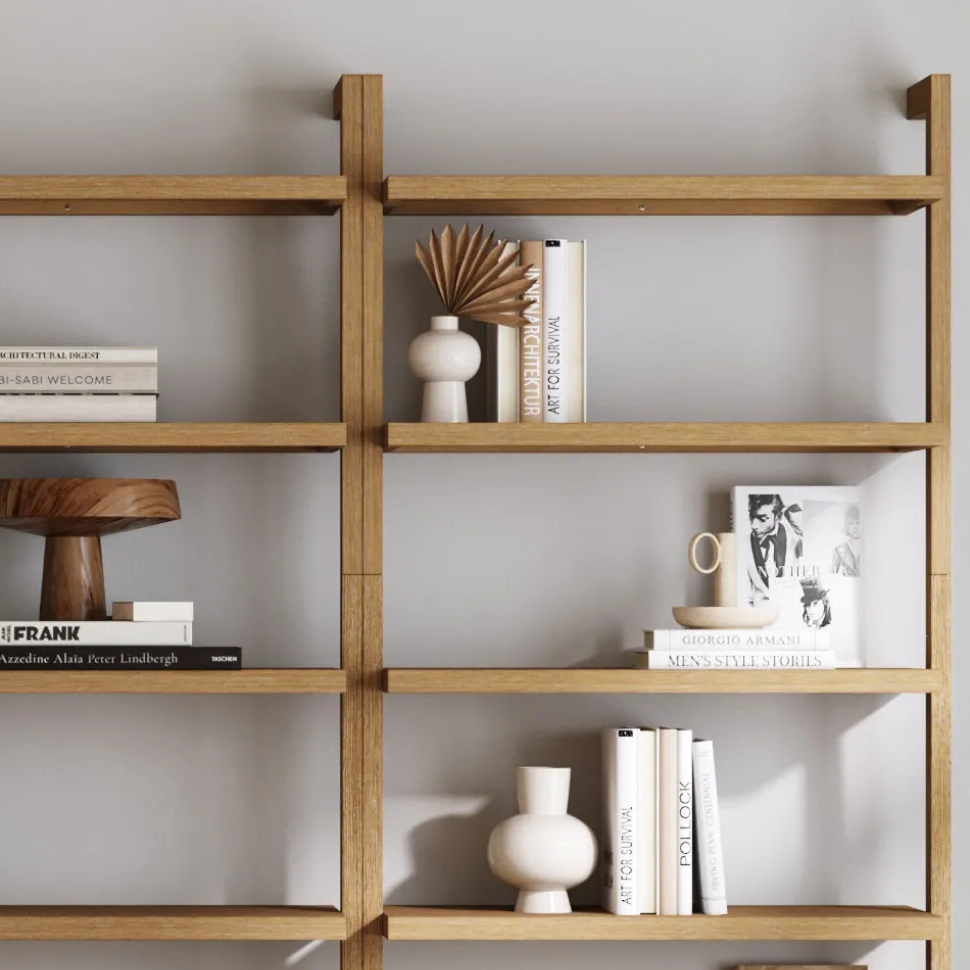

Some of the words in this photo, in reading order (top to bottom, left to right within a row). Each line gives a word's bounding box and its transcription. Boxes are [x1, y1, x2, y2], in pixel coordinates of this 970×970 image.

[548, 316, 560, 365] SURVIVAL
[69, 351, 100, 360] DIGEST
[47, 375, 113, 385] WELCOME
[548, 368, 560, 389] FOR
[548, 391, 560, 415] ART
[13, 626, 80, 641] FRANK
[682, 635, 740, 645] GIORGIO
[746, 635, 801, 645] ARMANI
[88, 653, 116, 664] Peter
[120, 652, 178, 667] Lindbergh
[668, 655, 711, 667] MEN'S
[714, 655, 758, 667] STYLE
[762, 655, 822, 667] STORIES
[621, 806, 633, 855] SURVIVAL
[680, 781, 691, 867] POLLOCK
[621, 858, 633, 881] FOR
[621, 885, 633, 905] ART
